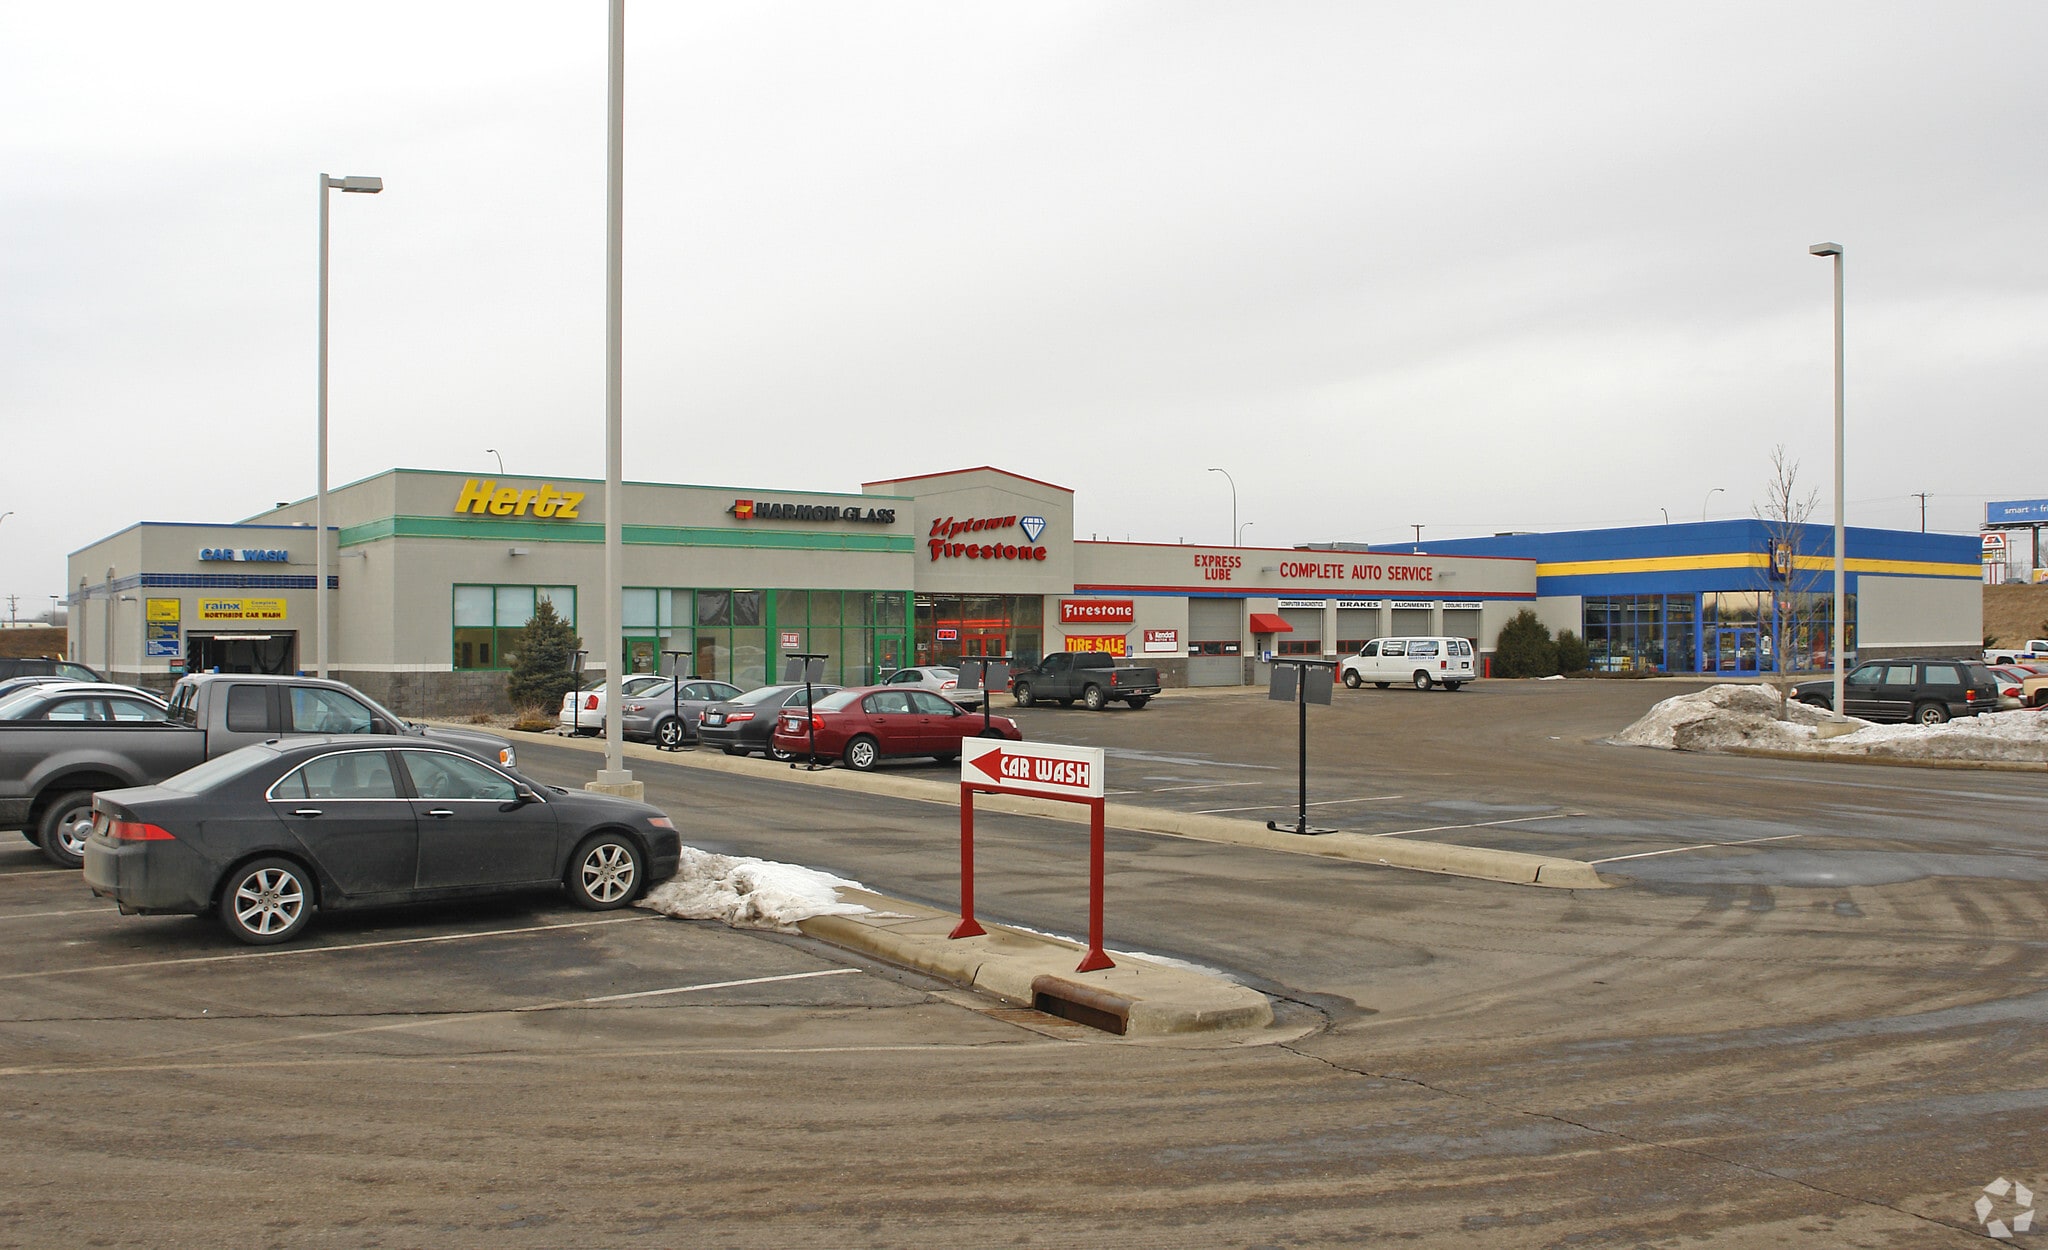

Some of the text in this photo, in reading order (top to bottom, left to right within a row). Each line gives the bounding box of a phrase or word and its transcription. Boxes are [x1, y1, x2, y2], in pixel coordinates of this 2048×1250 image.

[454, 479, 585, 518] Hertz
[755, 502, 896, 524] HARMON GLASS
[2004, 506, 2028, 514] smart
[929, 515, 1016, 539] Uptown
[201, 548, 288, 562] CAR WASH
[927, 538, 1047, 562] Firestone
[1194, 554, 1241, 568] EXPRESS
[1204, 568, 1231, 580] LUBE
[1280, 562, 1432, 581] COMPLETE AUTO SERVICE
[1063, 603, 1132, 618] Firestone
[1066, 637, 1093, 652] TIRE
[1095, 637, 1125, 654] SALE
[1000, 756, 1089, 785] CAR WASH
